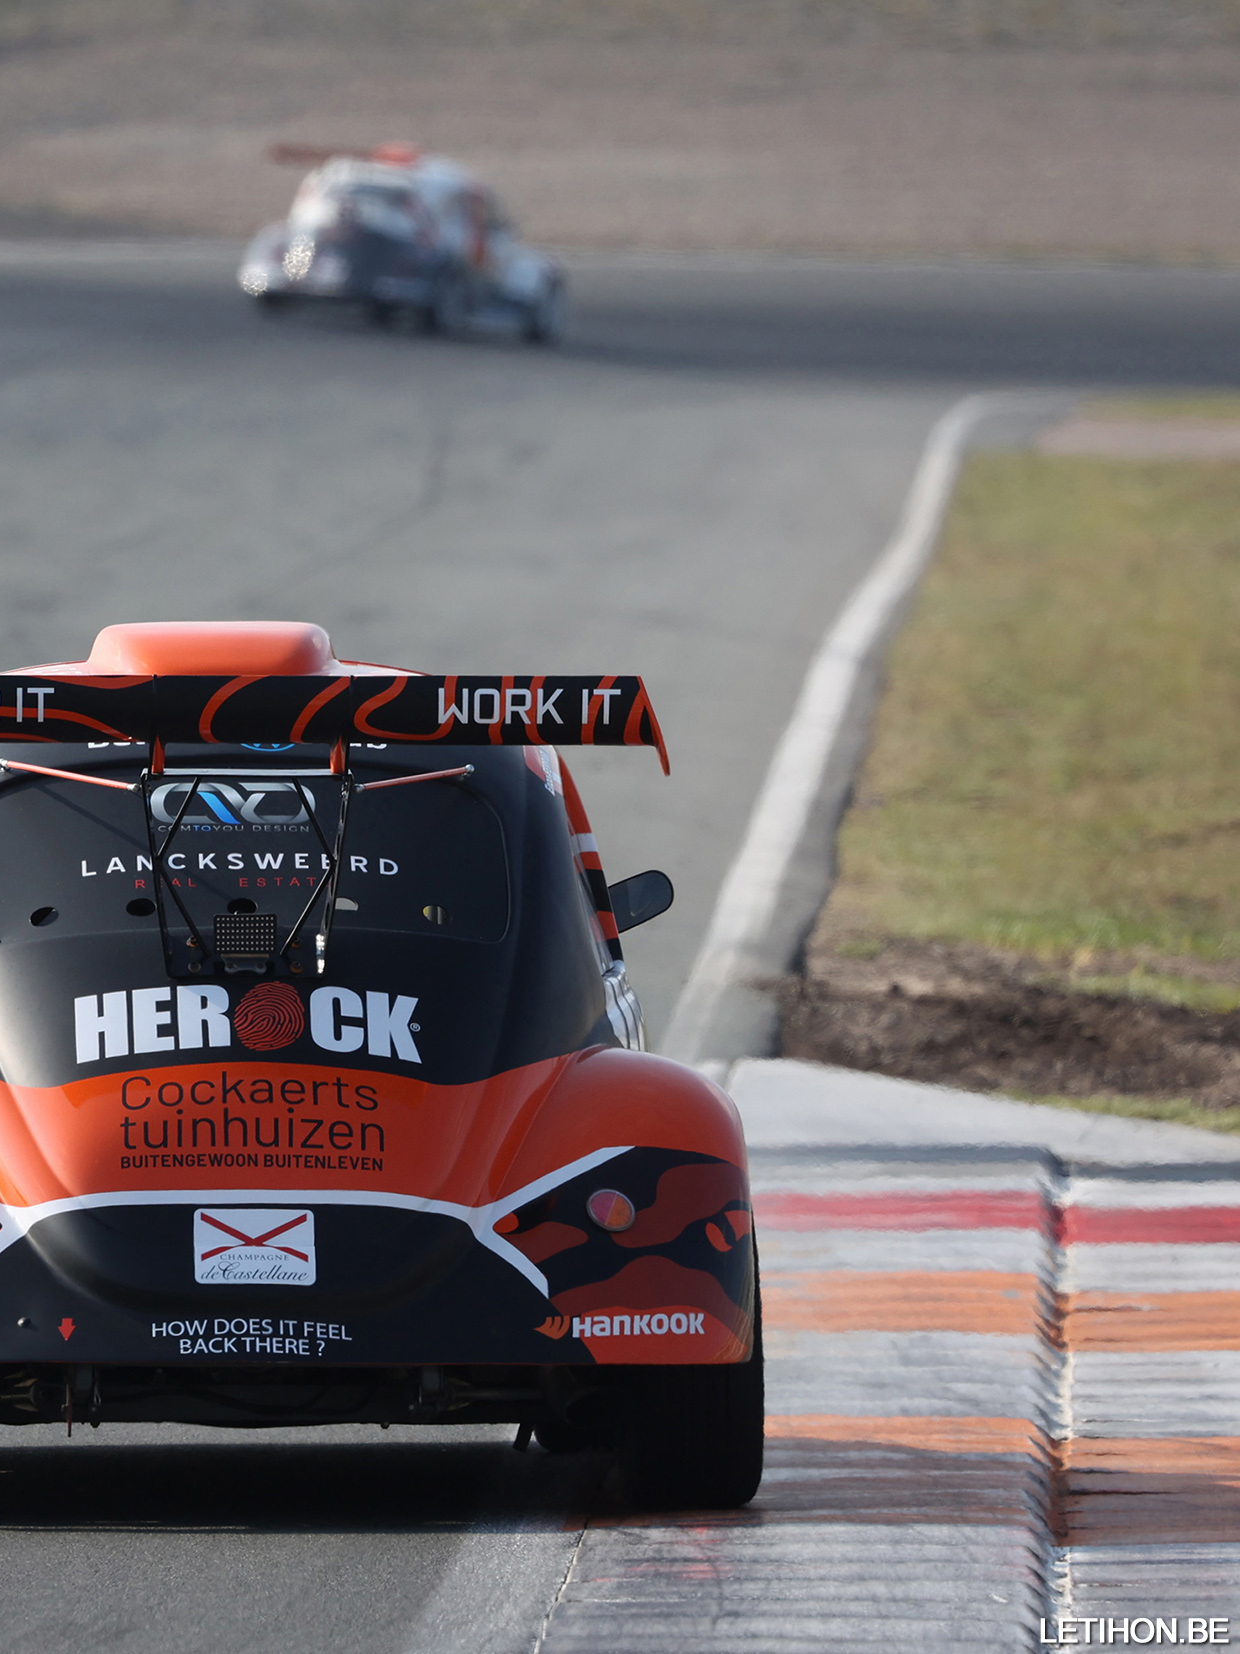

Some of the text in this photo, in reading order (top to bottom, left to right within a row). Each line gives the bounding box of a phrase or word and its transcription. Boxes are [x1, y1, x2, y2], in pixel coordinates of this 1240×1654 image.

[16, 687, 55, 723] IT
[437, 687, 621, 725] WORK IT
[252, 824, 310, 833] DESIGN
[81, 852, 399, 877] LANCKSWEERD
[135, 876, 330, 889] RAL ESTAT
[121, 1071, 379, 1112] Cockaerts
[120, 1108, 385, 1152] tuinhuizen
[120, 1154, 384, 1171] BUITENGEWOON BUITENLEVEN
[220, 1253, 289, 1261] CHAMPAGNE
[218, 1261, 309, 1282] Castellane
[152, 1318, 353, 1341] HOW DOES IT FEEL
[180, 1337, 326, 1356] BACK THERE ?
